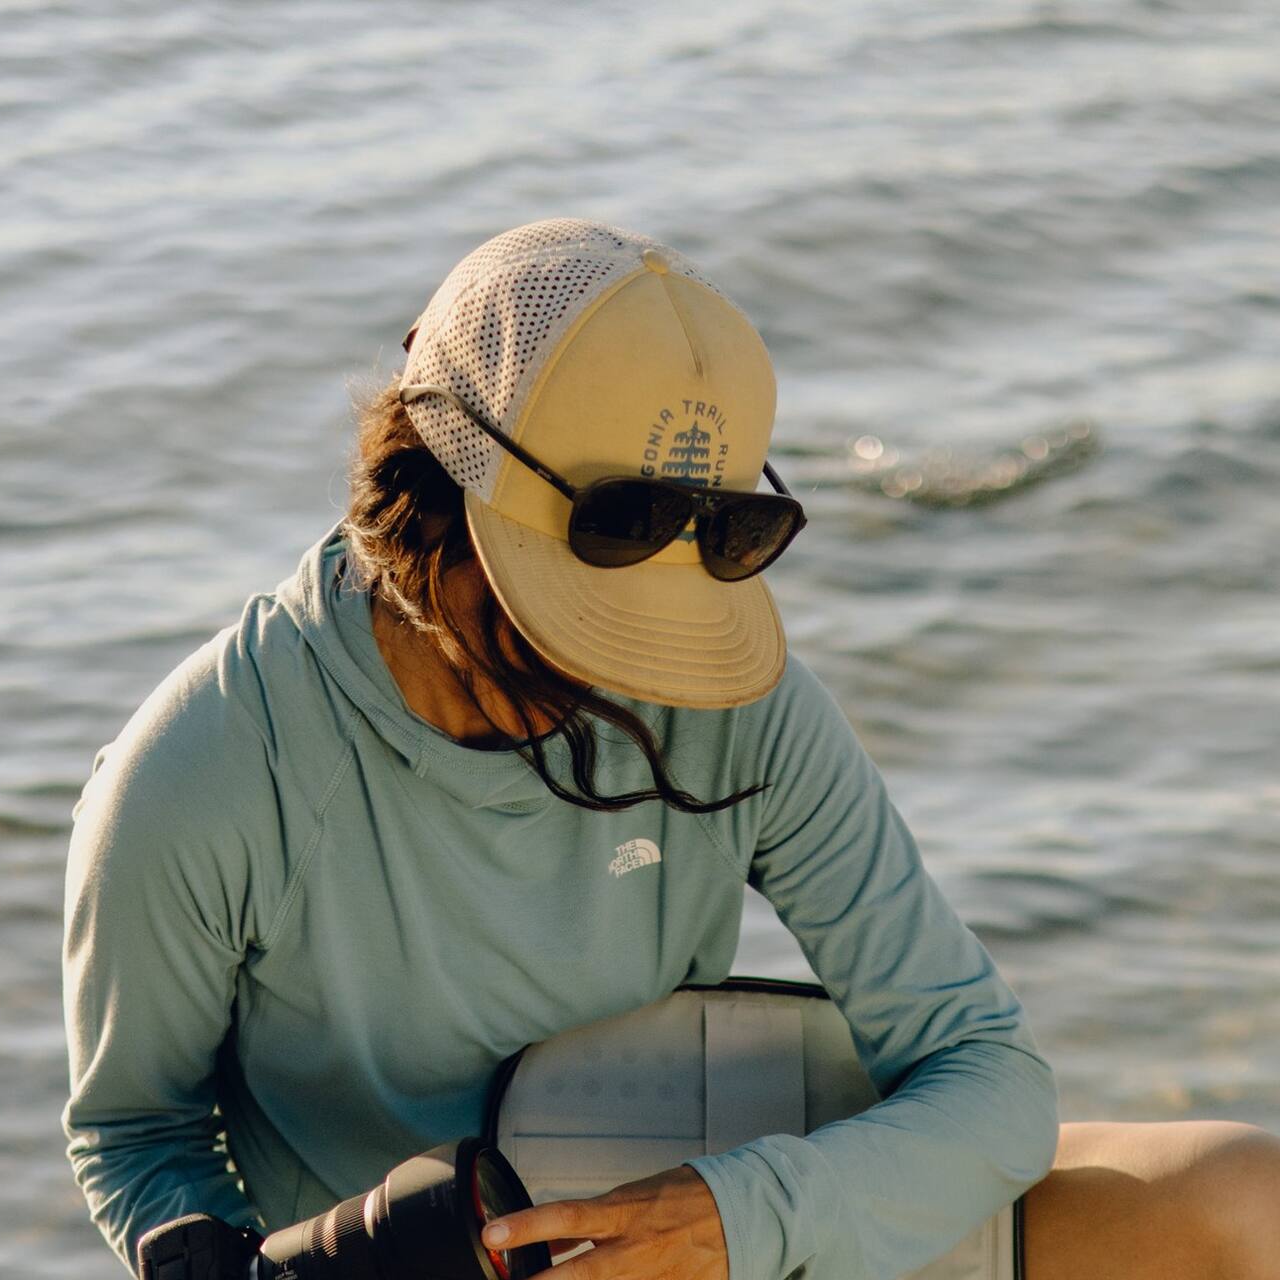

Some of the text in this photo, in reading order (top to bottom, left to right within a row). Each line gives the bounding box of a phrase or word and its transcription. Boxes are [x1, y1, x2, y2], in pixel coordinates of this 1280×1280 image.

[640, 399, 729, 487] GONIA TRAIL RUN
[615, 840, 637, 857] THE
[615, 858, 641, 879] FACE
